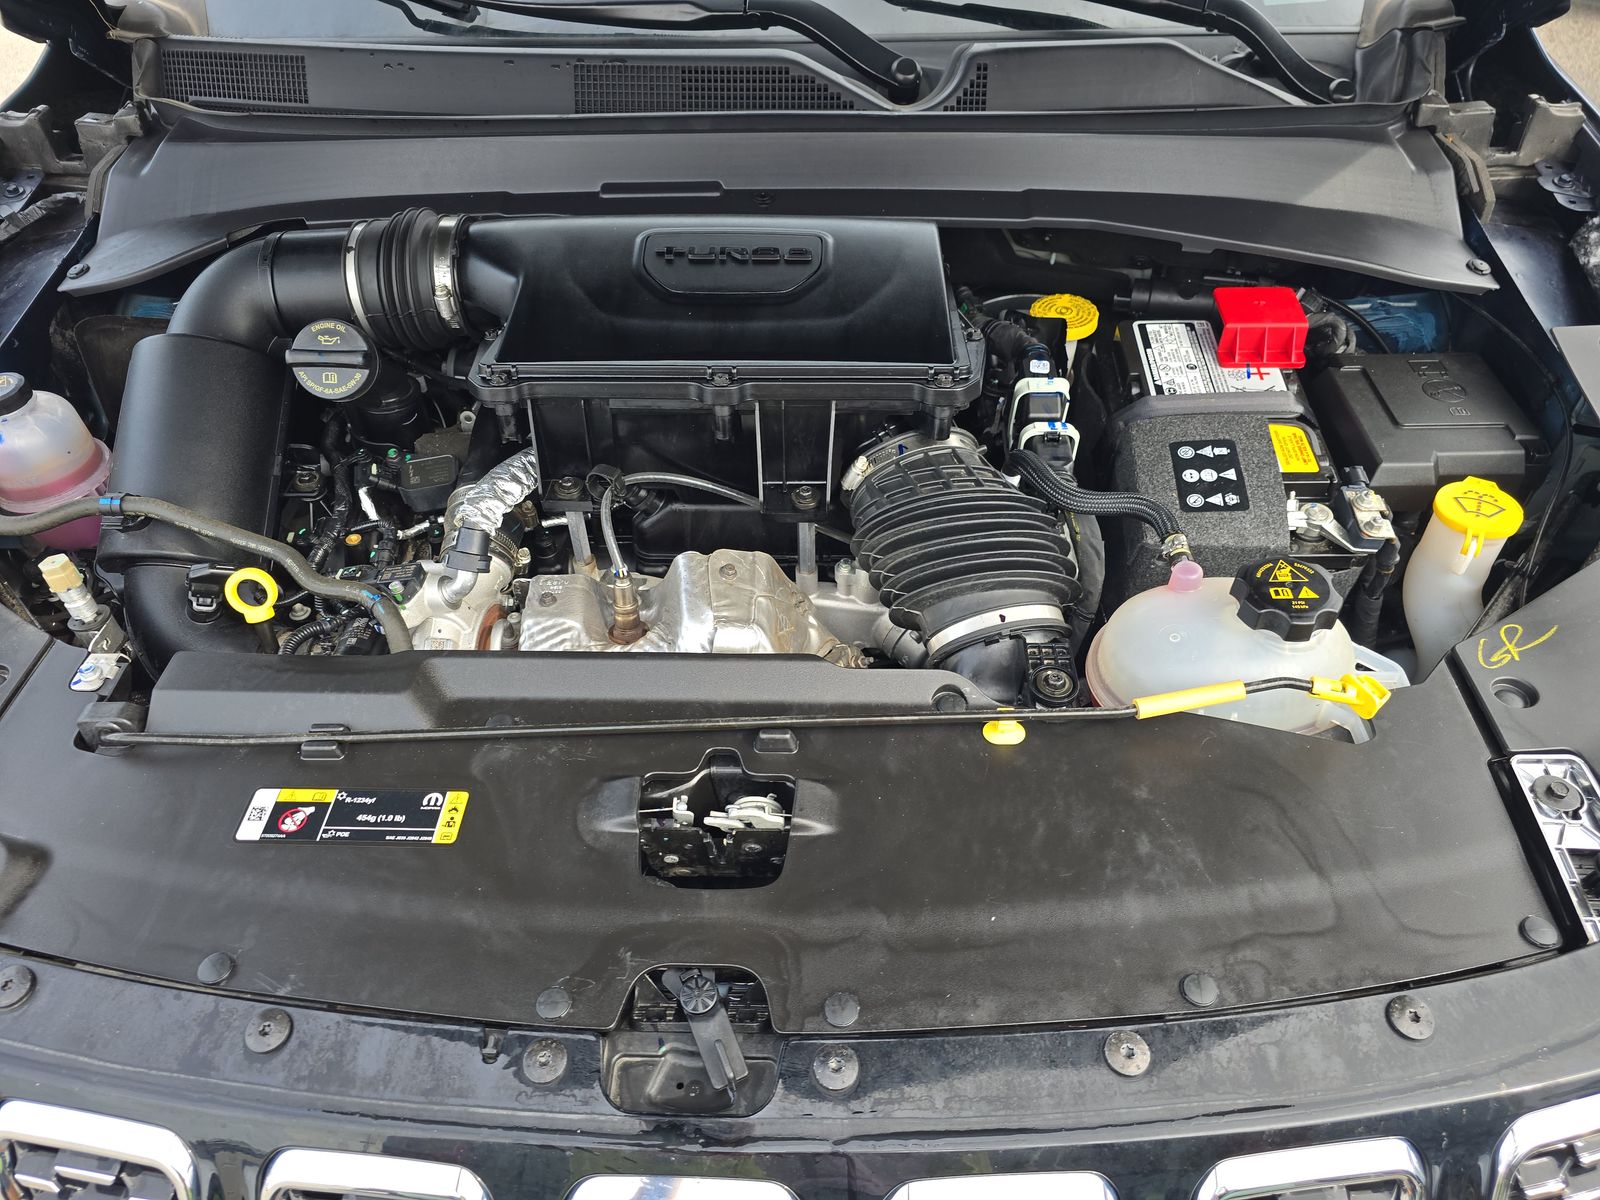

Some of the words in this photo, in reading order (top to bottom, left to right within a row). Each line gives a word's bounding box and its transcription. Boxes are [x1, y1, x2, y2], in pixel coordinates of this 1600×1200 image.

[655, 246, 813, 262] TURBO
[311, 323, 335, 332] ENGINE
[336, 323, 346, 333] OIL
[298, 371, 307, 381] API
[345, 797, 377, 805] R-1234yf
[356, 814, 376, 823] 454g
[377, 814, 393, 823] (1.0
[394, 814, 406, 823] lb)
